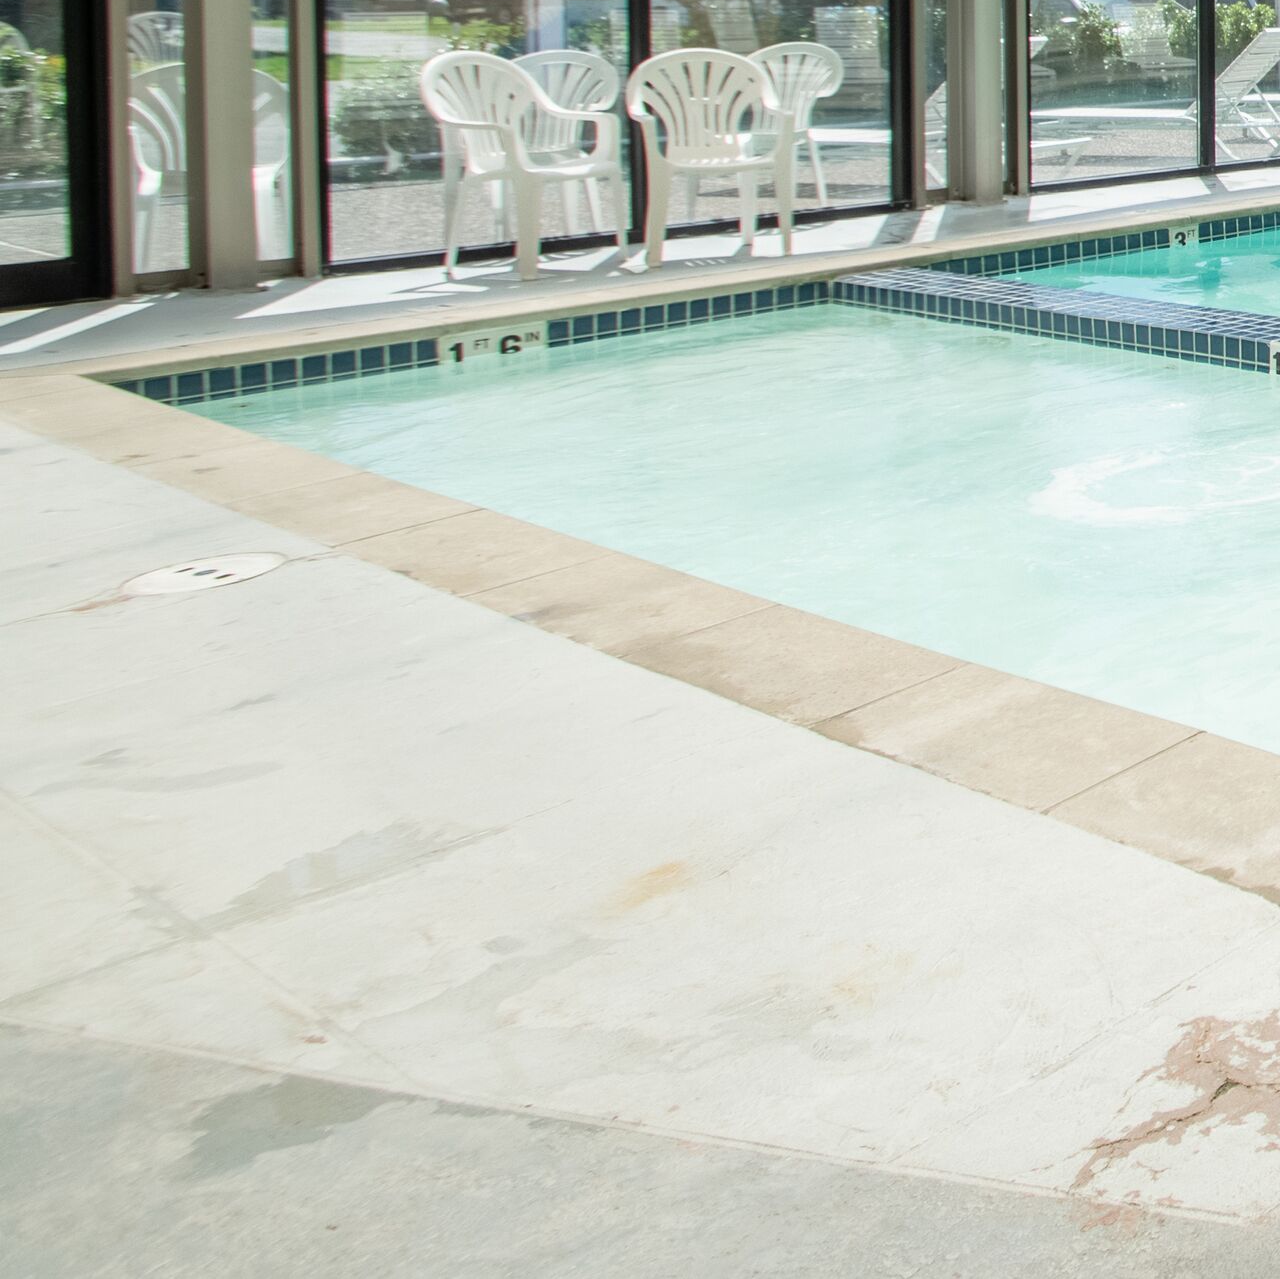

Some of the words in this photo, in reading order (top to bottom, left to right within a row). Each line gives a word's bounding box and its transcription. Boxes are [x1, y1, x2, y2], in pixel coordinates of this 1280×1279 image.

[1174, 231, 1186, 246] 3
[449, 342, 464, 362] 1
[474, 338, 490, 350] FT
[500, 334, 522, 354] 6
[524, 331, 540, 342] IN
[1273, 352, 1280, 375] 1
